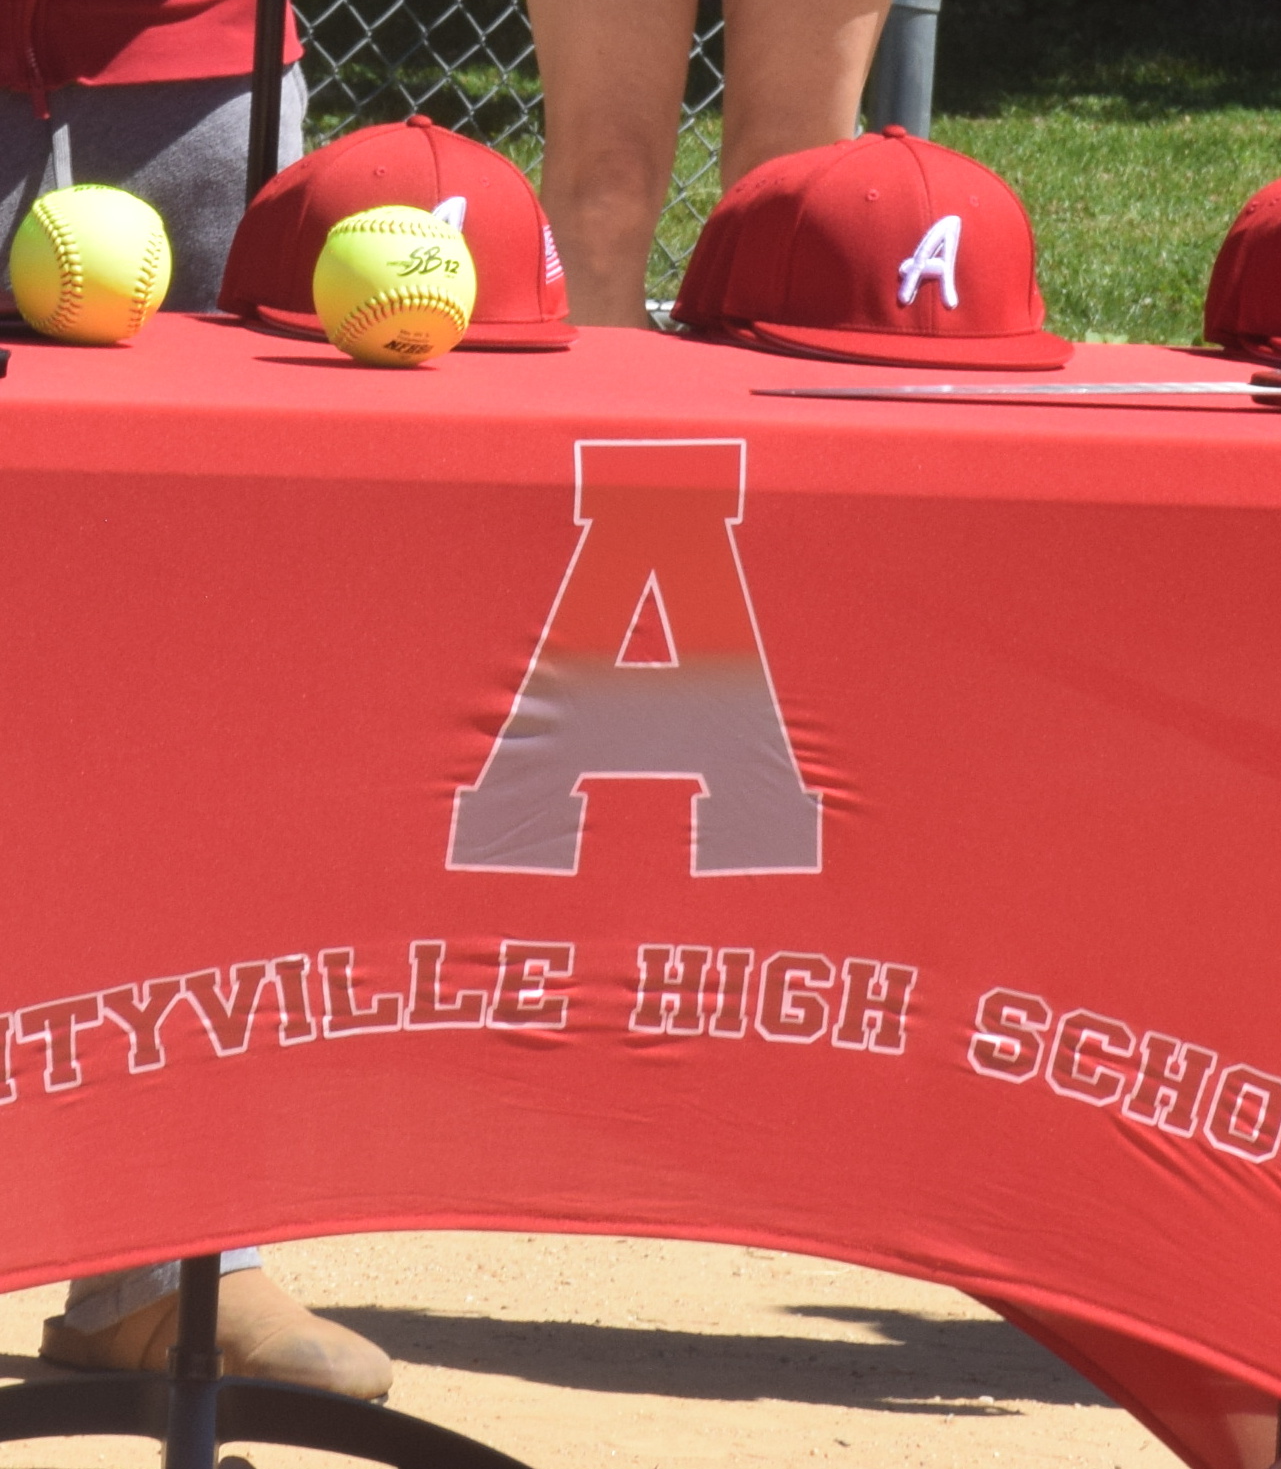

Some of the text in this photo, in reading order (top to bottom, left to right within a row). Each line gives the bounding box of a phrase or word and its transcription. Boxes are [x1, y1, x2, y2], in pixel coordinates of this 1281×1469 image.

[445, 260, 460, 274] 12
[898, 215, 962, 309] A
[445, 438, 821, 876] A
[628, 944, 917, 1055] HIGH
